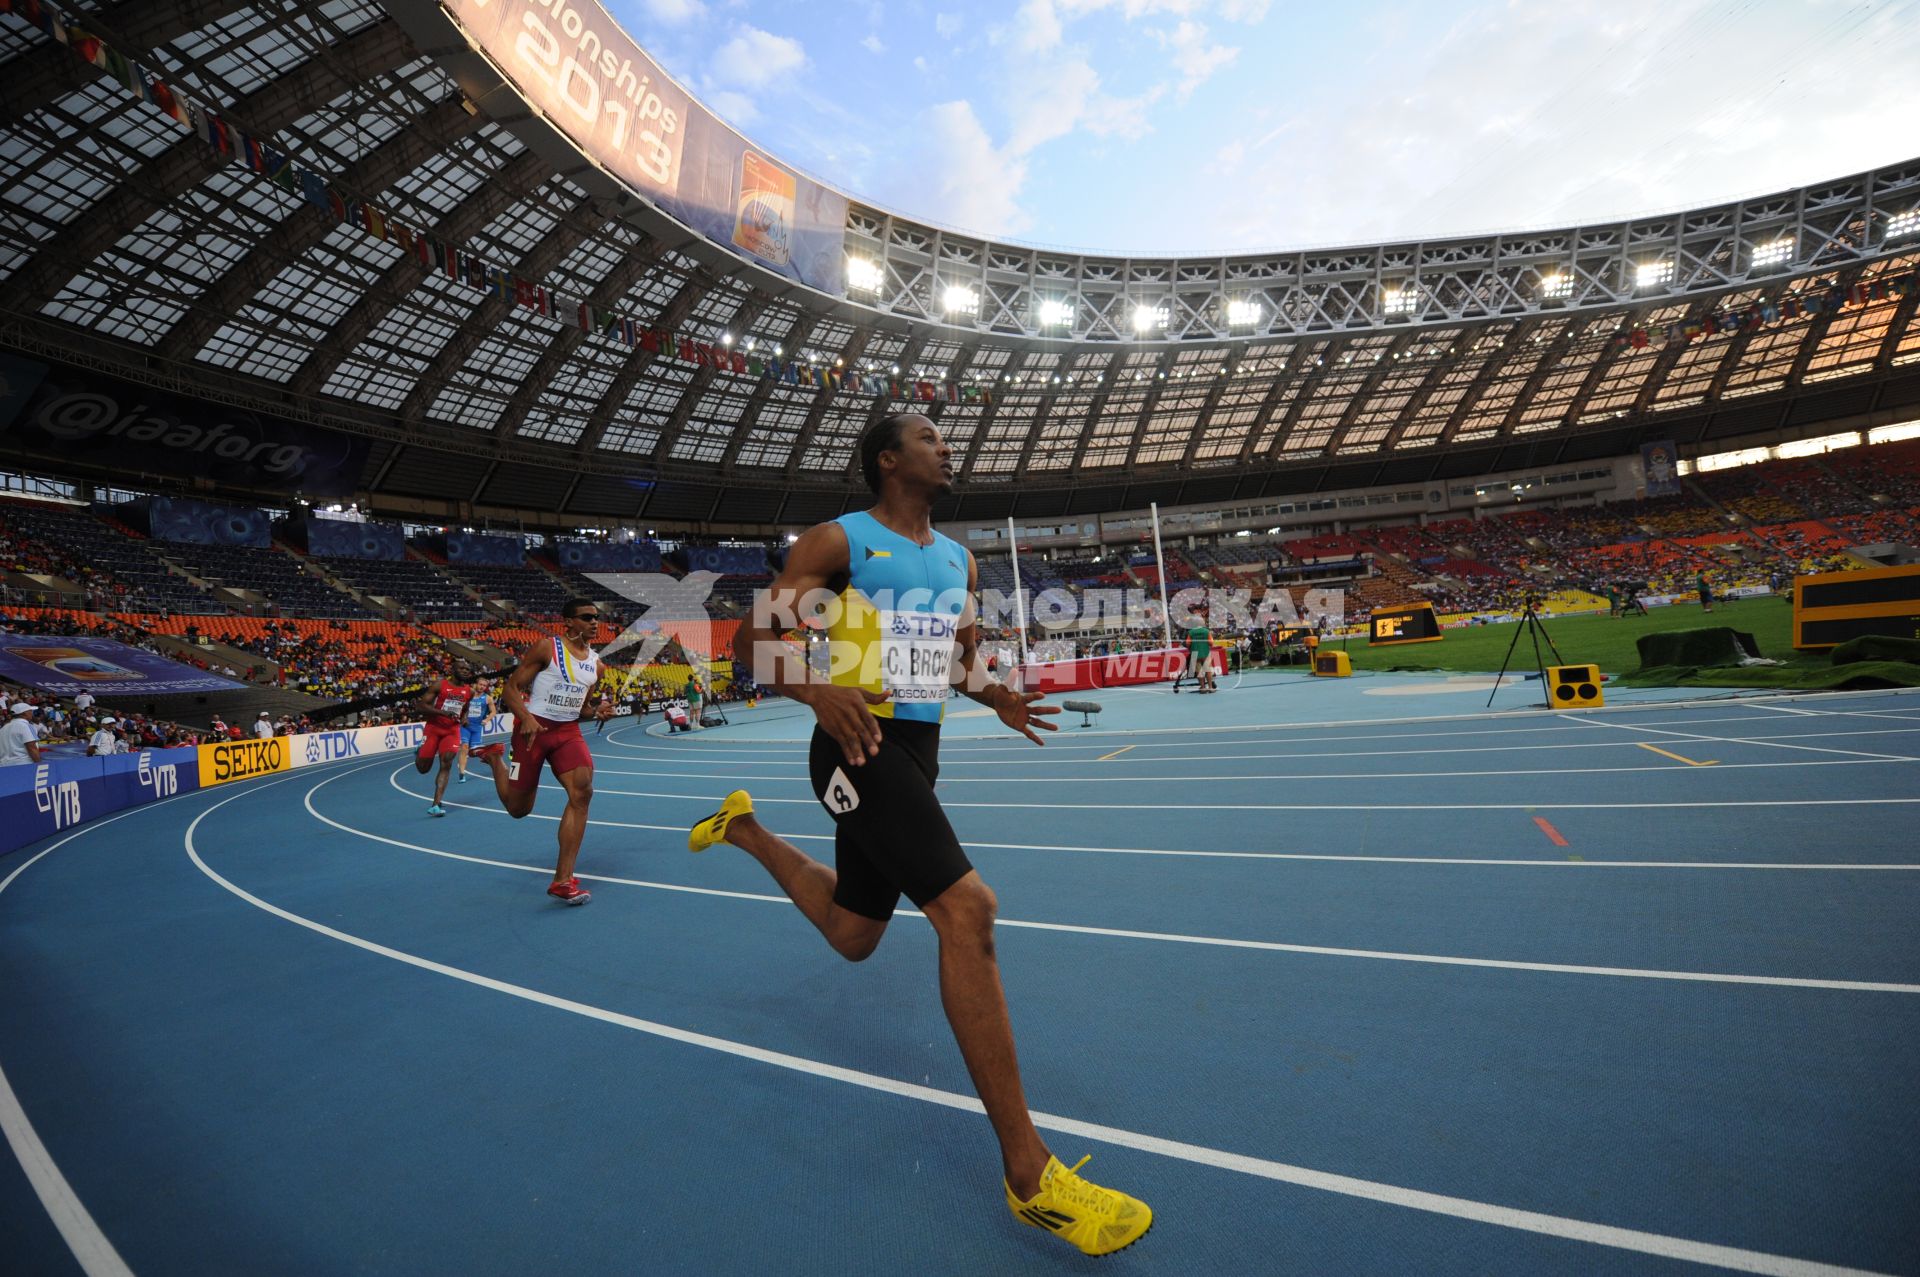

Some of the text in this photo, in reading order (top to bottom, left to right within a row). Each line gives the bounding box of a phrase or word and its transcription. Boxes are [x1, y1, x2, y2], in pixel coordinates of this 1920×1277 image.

[528, 0, 678, 134] ionships
[515, 11, 672, 184] 2013
[37, 393, 303, 473] @iaaforg
[911, 616, 957, 638] TDK
[578, 662, 595, 674] VEN
[887, 646, 949, 677] C. BROW
[562, 684, 585, 694] TDK
[398, 723, 425, 746] TD
[483, 715, 506, 735] DK
[214, 739, 281, 780] SEIKO
[319, 731, 361, 760] TDK
[152, 764, 178, 798] VTB
[510, 765, 516, 777] 7
[51, 781, 81, 830] VTB
